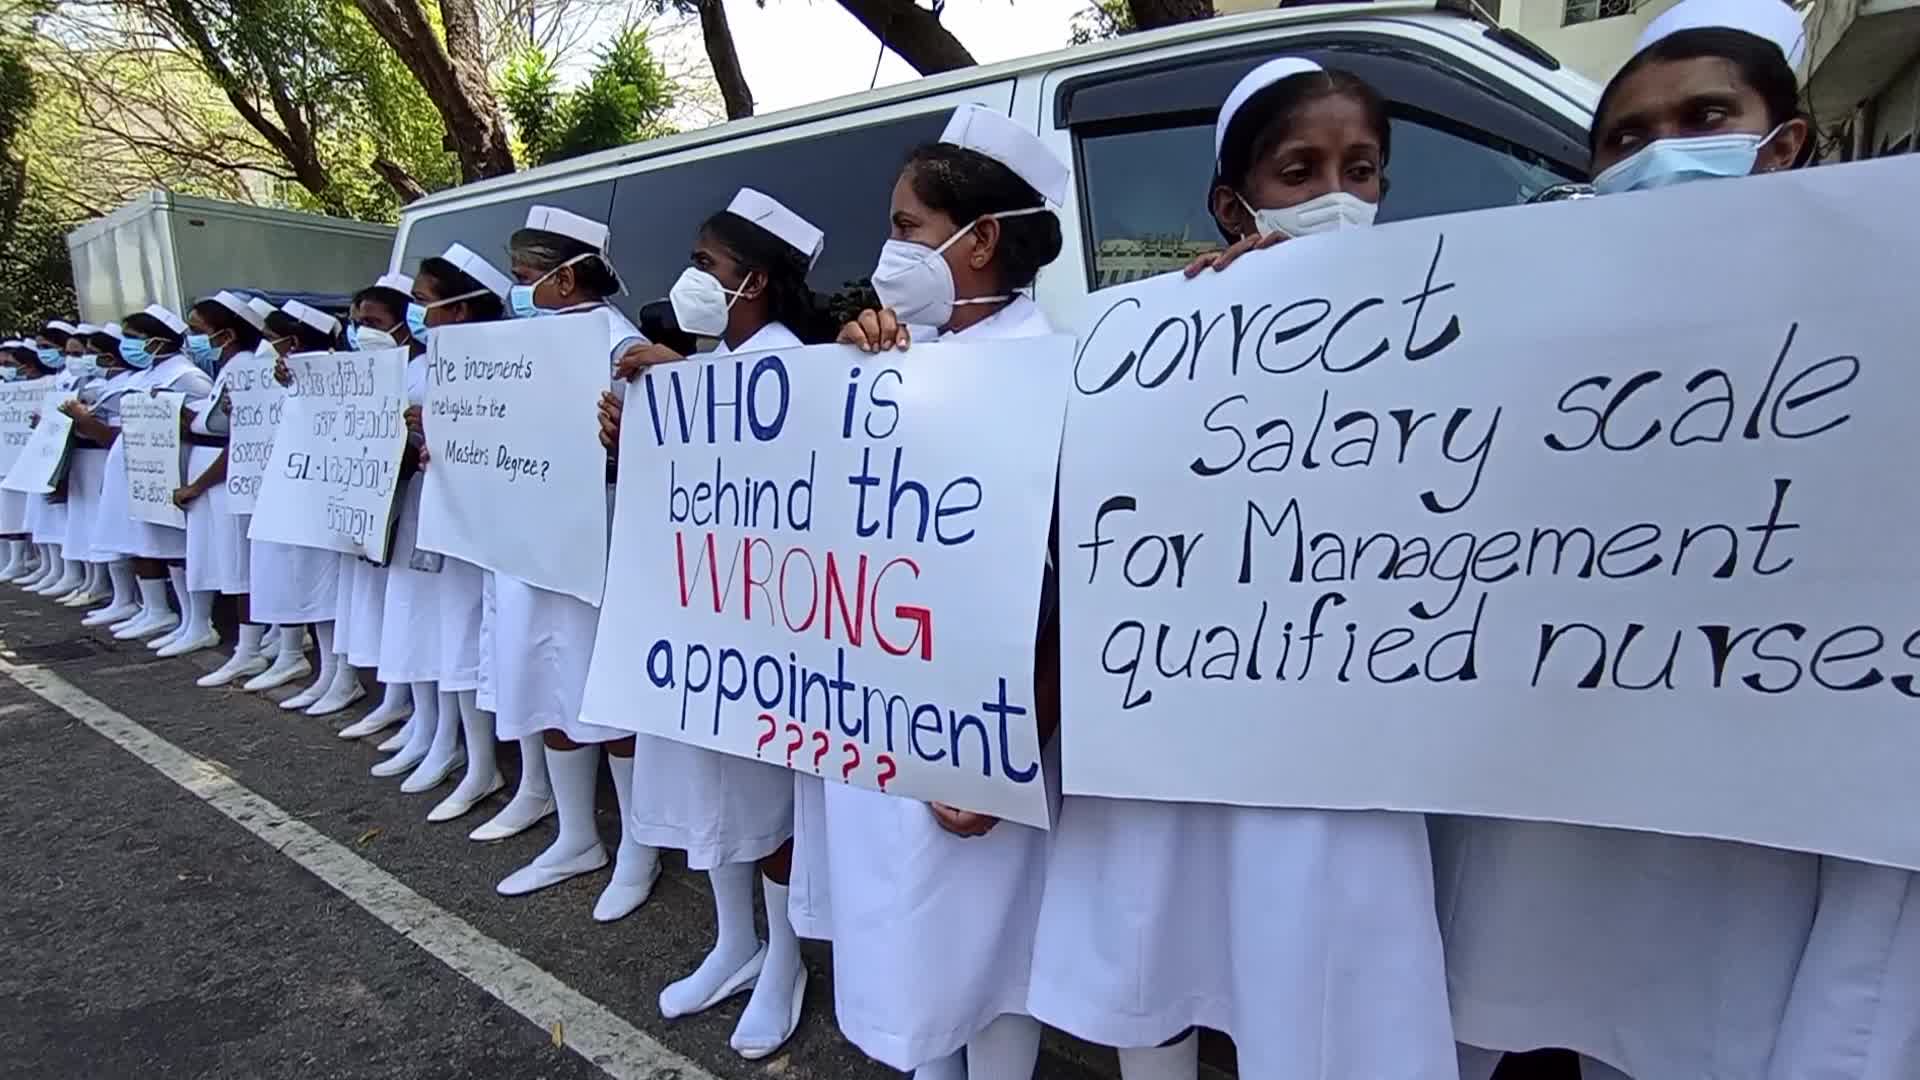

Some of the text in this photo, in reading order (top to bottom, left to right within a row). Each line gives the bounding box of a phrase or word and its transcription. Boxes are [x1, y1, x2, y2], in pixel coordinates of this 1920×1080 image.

[426, 335, 533, 386] Are increments
[1074, 233, 1461, 395] Correct
[644, 355, 903, 446] WHO is
[1190, 322, 1859, 514] Salary scale
[445, 440, 550, 482] Masters Degree?
[669, 446, 983, 546] behind the
[675, 531, 933, 661] WRONG
[1078, 478, 1800, 620] for Management
[1102, 592, 1488, 709] qualified
[646, 639, 1039, 784] appointment
[756, 713, 897, 793] ?????
